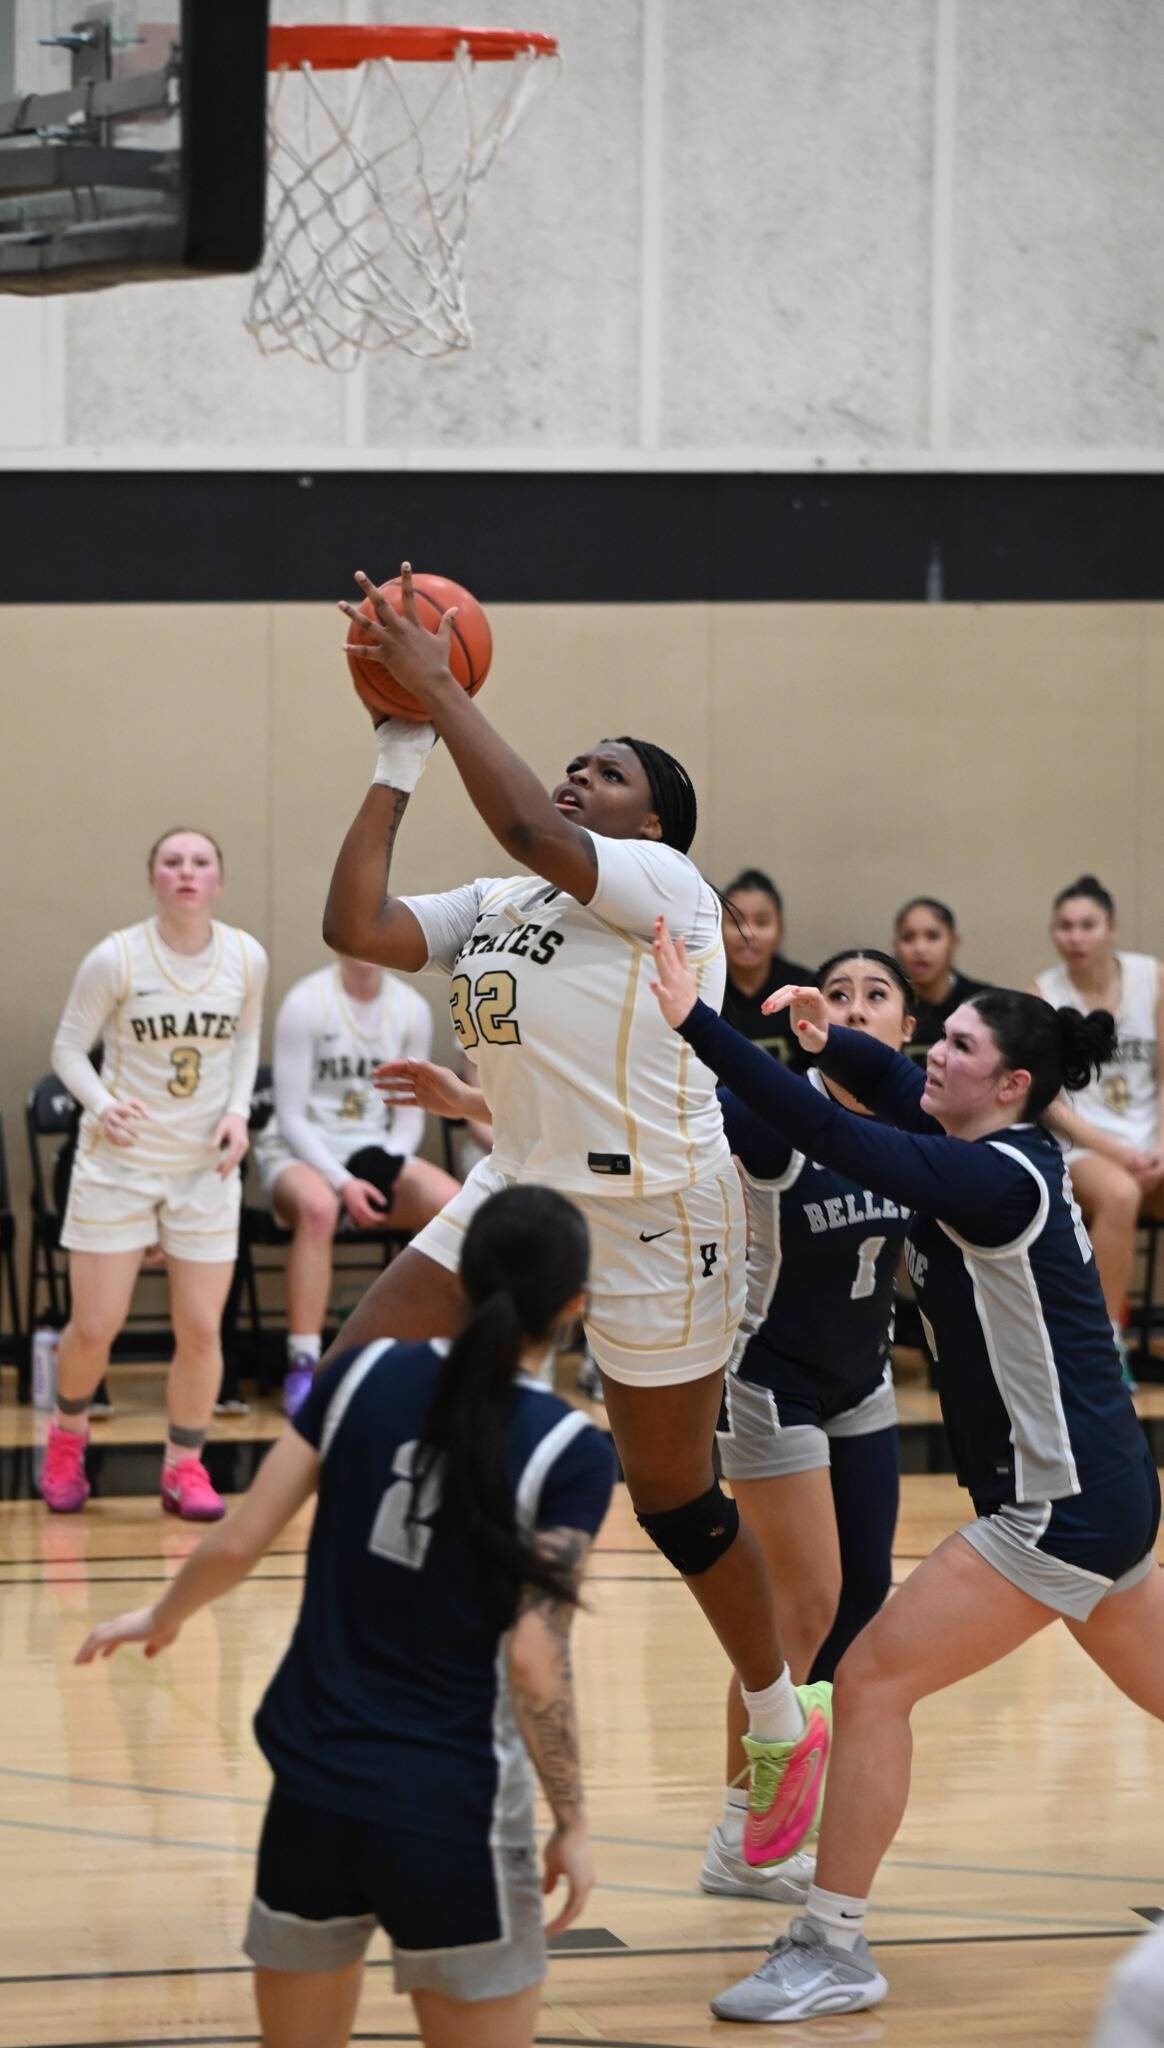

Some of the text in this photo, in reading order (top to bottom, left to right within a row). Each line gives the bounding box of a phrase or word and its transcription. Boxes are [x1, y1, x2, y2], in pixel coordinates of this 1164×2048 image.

[455, 923, 564, 965] RATES
[449, 969, 521, 1050] 32
[167, 1046, 201, 1099] 3
[699, 1241, 718, 1278] P
[850, 1235, 887, 1300] 1
[368, 1439, 444, 1570] 2
